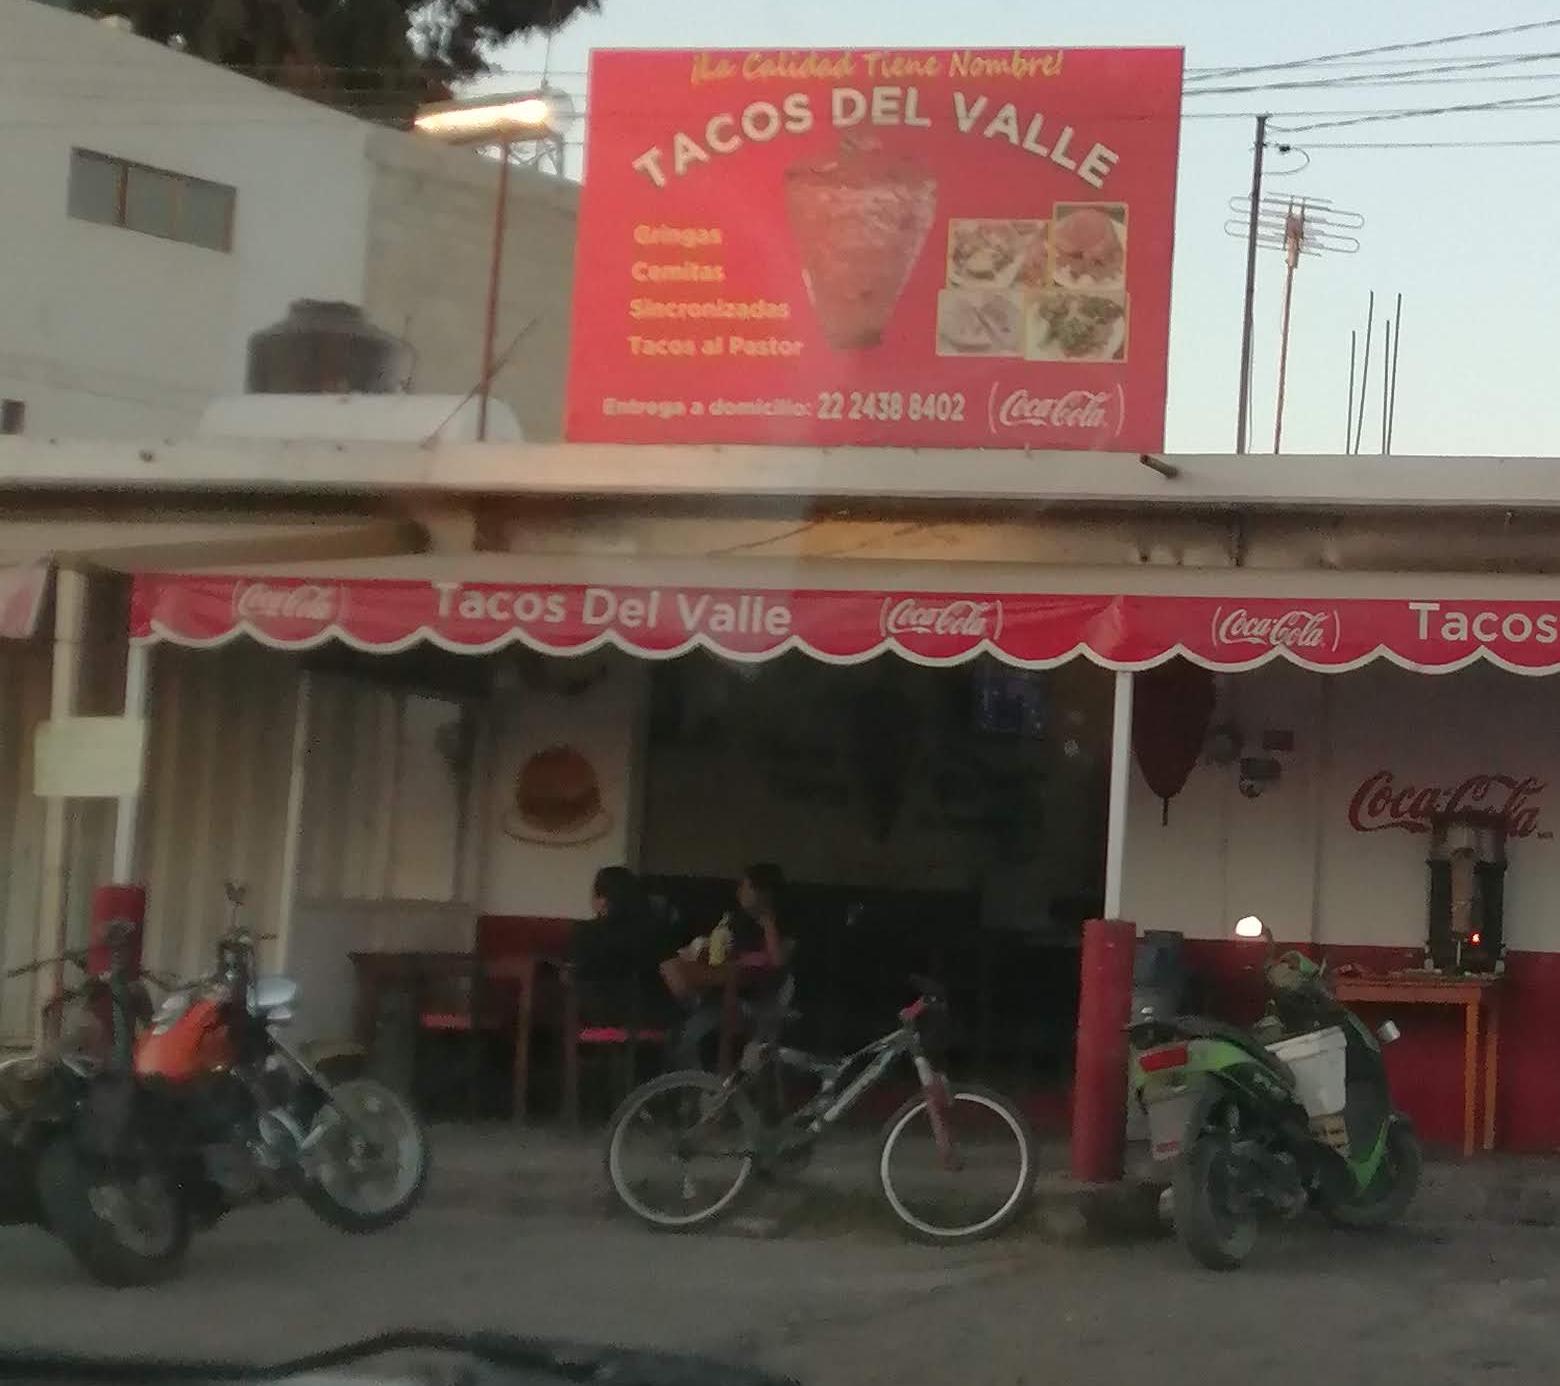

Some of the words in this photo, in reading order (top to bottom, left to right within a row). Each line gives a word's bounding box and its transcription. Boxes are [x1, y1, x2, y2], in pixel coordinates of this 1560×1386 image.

[742, 51, 856, 79] Calidad
[863, 51, 941, 78] Tiene
[949, 49, 1065, 80] Nombre!
[631, 92, 815, 189] TACOS
[831, 86, 932, 129] DEL
[953, 90, 1121, 190] VALLE
[633, 223, 722, 248] Gringas
[631, 261, 726, 282] Cemitas
[629, 297, 792, 320] Sincronizadas
[627, 335, 697, 356] Tacos
[701, 335, 724, 356] al
[729, 335, 804, 356] Pastor
[602, 397, 686, 419] Entrega
[690, 401, 704, 416] a
[817, 391, 845, 421] 22
[849, 391, 903, 421] 2438
[908, 392, 967, 422] 8402
[1000, 388, 1110, 428] Coca-Cola
[432, 581, 567, 625] Tacos
[582, 588, 658, 628] Del
[676, 593, 793, 636] Valle
[886, 597, 990, 636] Coca-Cola
[1408, 602, 1559, 645] Tacos
[1218, 608, 1328, 649] Coca-Cola
